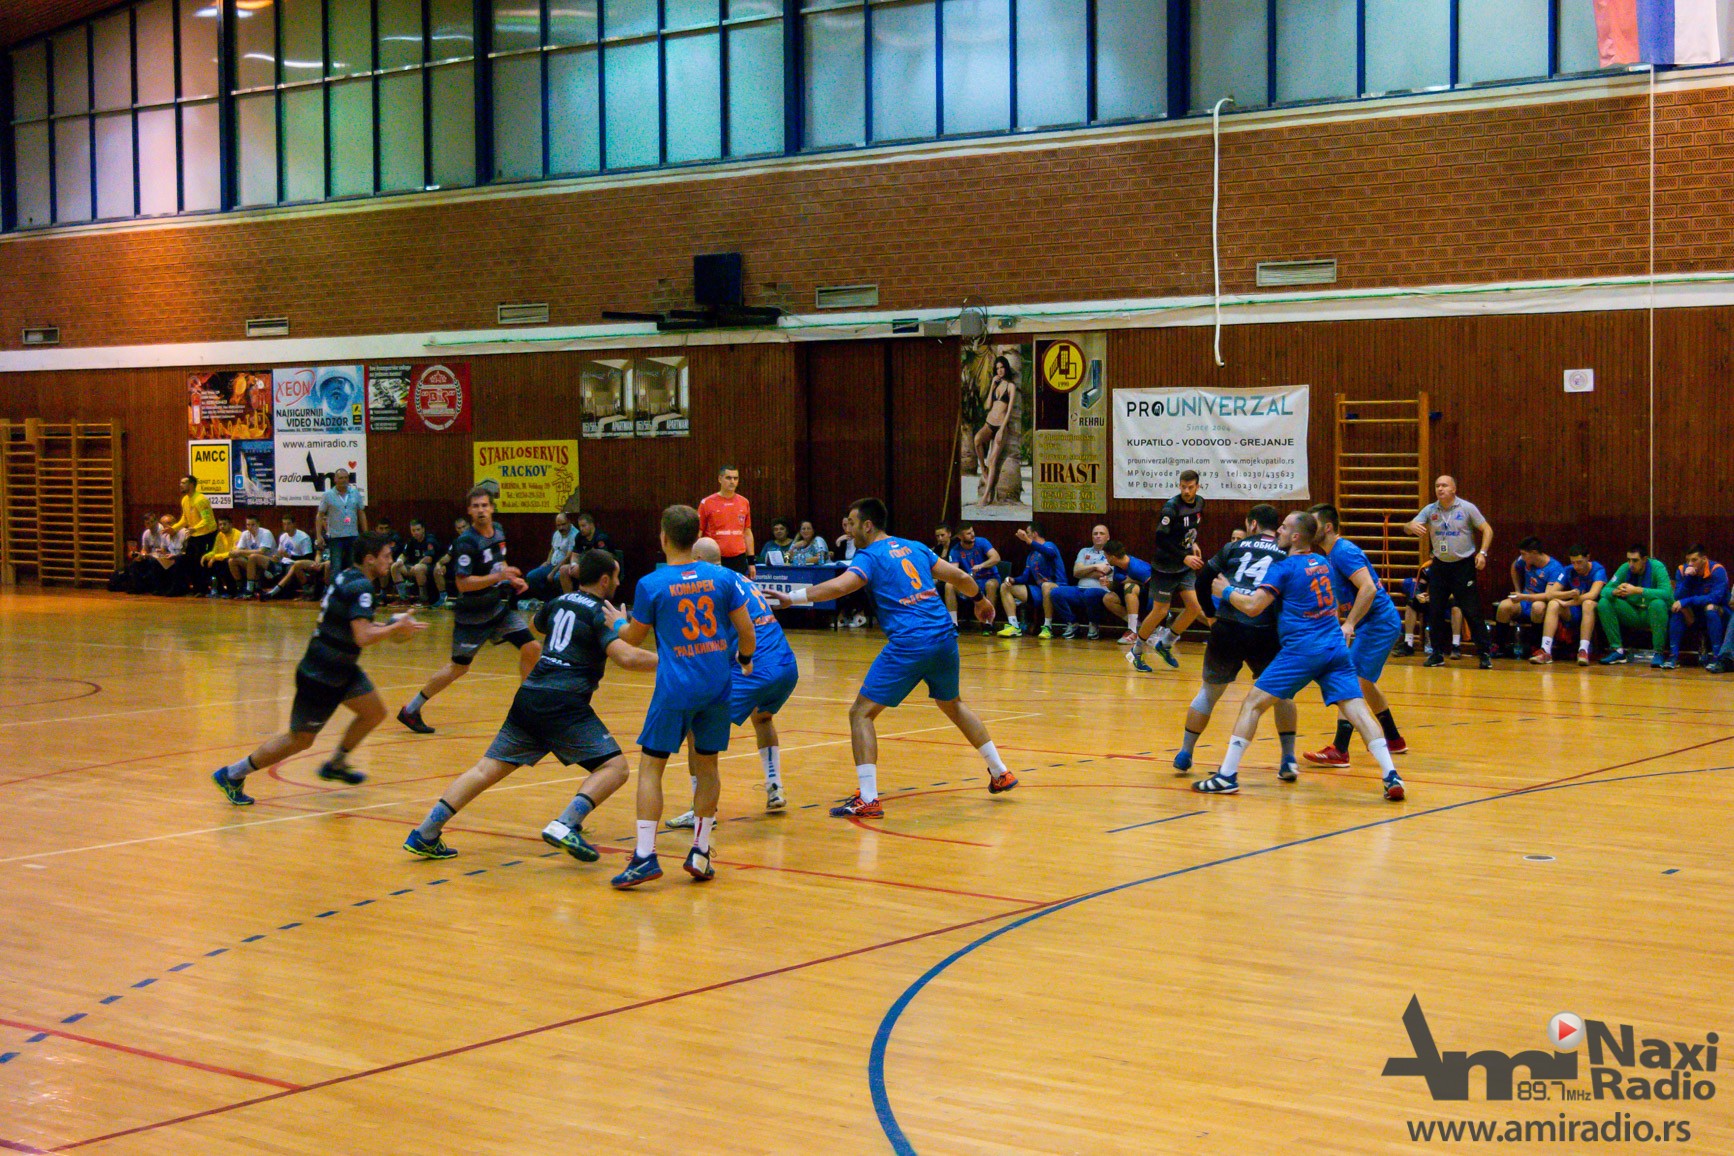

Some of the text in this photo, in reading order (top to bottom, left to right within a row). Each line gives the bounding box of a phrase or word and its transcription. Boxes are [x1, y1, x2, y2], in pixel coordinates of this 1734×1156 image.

[276, 381, 311, 402] XEON
[276, 408, 323, 417] NAJSIGURNIJI
[1127, 395, 1293, 417] PROUNIVERZAL
[287, 418, 311, 427] VIDEO
[314, 417, 348, 426] NADZOR
[1079, 417, 1104, 426] REHAU
[1186, 423, 1209, 431] Since
[282, 439, 358, 448] www.amiradio.rs
[480, 445, 568, 466] STAKLOSERVIS
[1220, 458, 1294, 466] www.mojekupatilo.rs
[279, 473, 301, 482] radio
[1040, 462, 1100, 483] HRAST
[1141, 470, 1173, 478] Vojvode
[1183, 516, 1190, 527] 11
[901, 558, 922, 590] 9
[1234, 552, 1273, 587] 14
[669, 579, 715, 597] КОМАРЕК
[1310, 576, 1334, 608] 13
[678, 595, 717, 641] 33
[549, 608, 576, 652] 10
